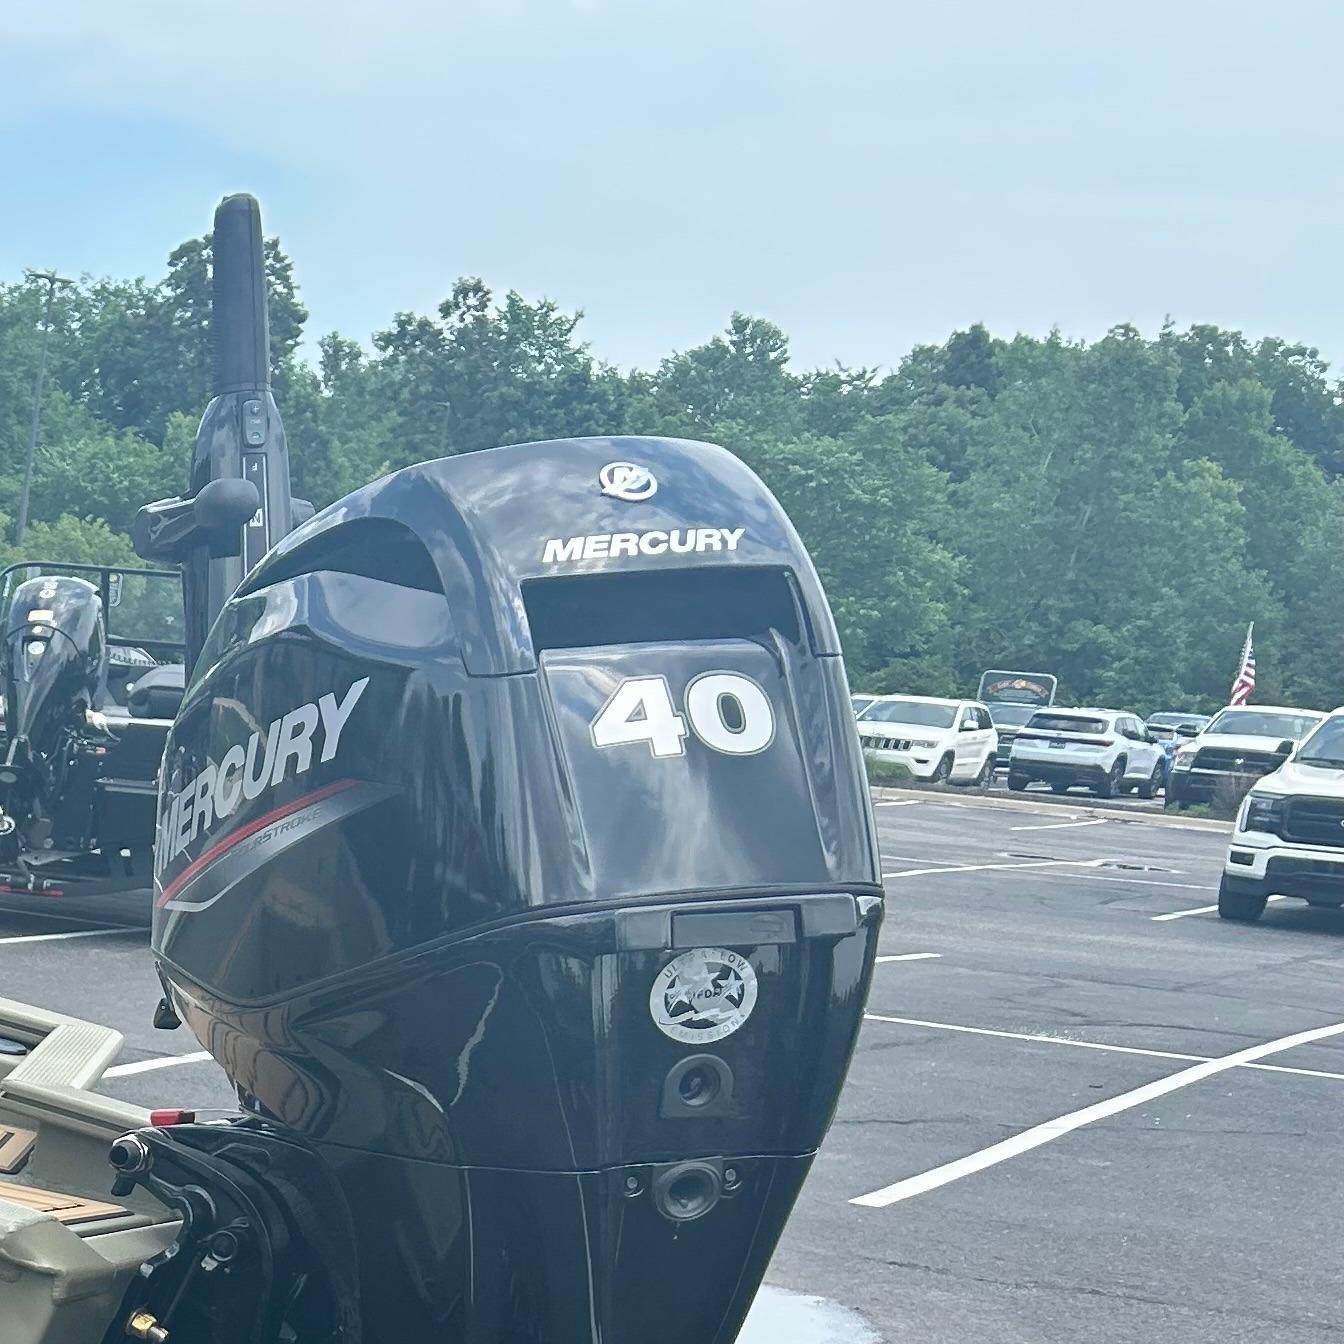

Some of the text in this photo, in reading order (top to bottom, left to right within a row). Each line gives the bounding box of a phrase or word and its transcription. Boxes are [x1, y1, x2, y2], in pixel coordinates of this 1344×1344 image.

[542, 527, 746, 563] MERCURY
[589, 669, 777, 759] 40
[157, 676, 370, 877] MERCURY
